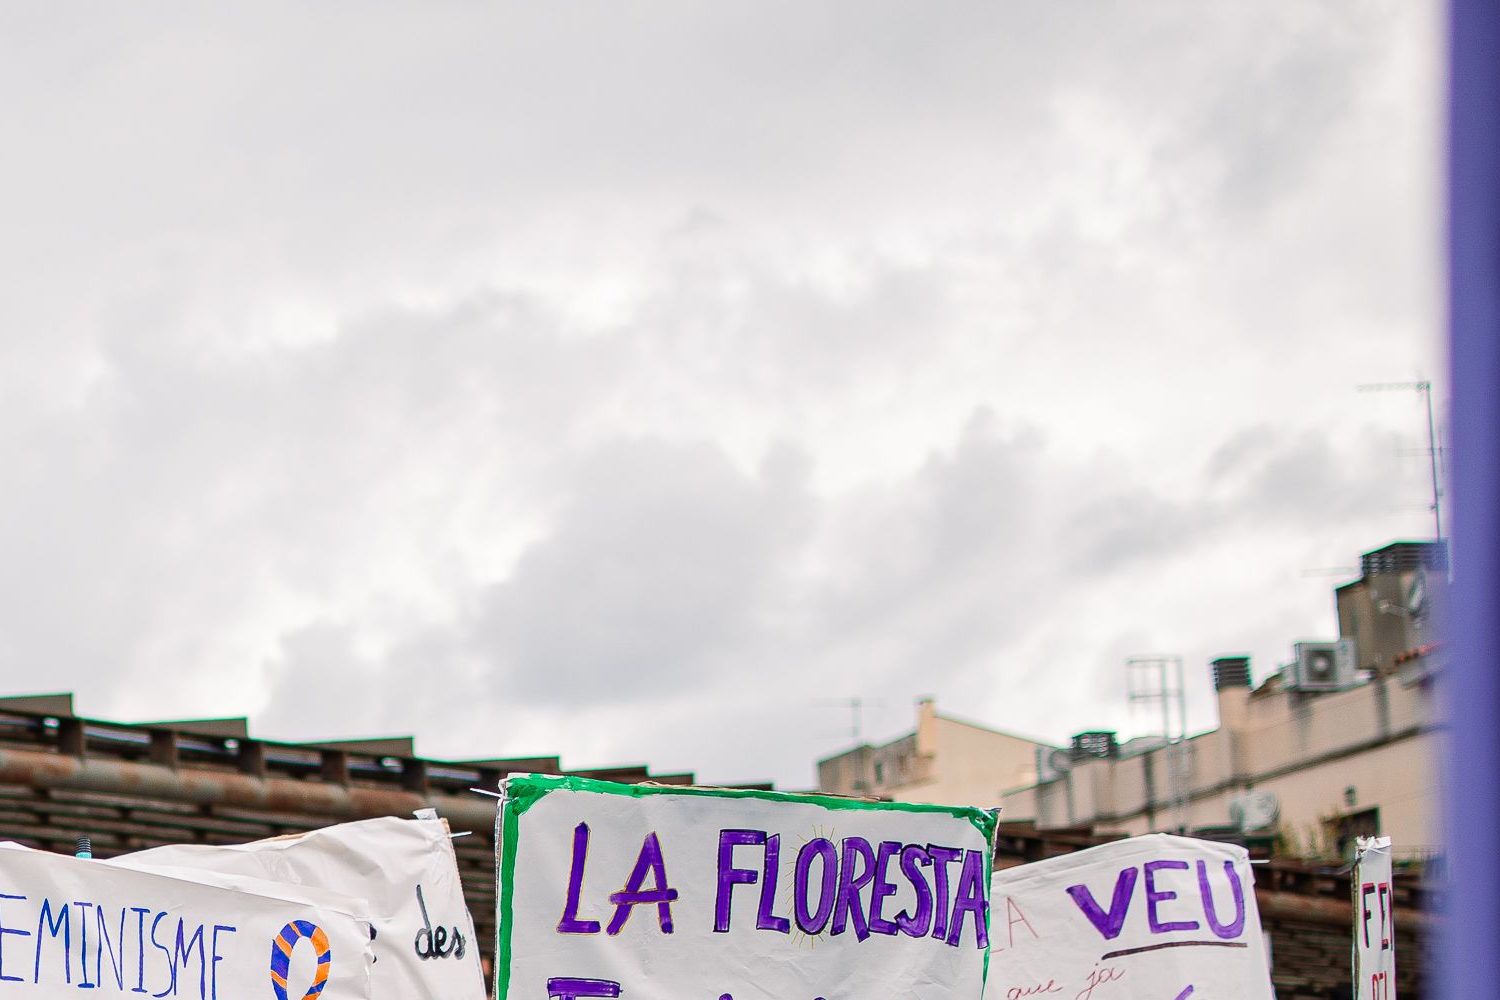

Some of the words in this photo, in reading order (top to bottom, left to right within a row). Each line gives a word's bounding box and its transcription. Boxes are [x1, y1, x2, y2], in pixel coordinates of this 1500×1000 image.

[414, 884, 467, 961] des
[557, 820, 679, 936] LA
[712, 828, 990, 949] FLORESTA
[989, 895, 1040, 954] A
[1065, 859, 1246, 940] VEU
[1362, 882, 1394, 951] FE
